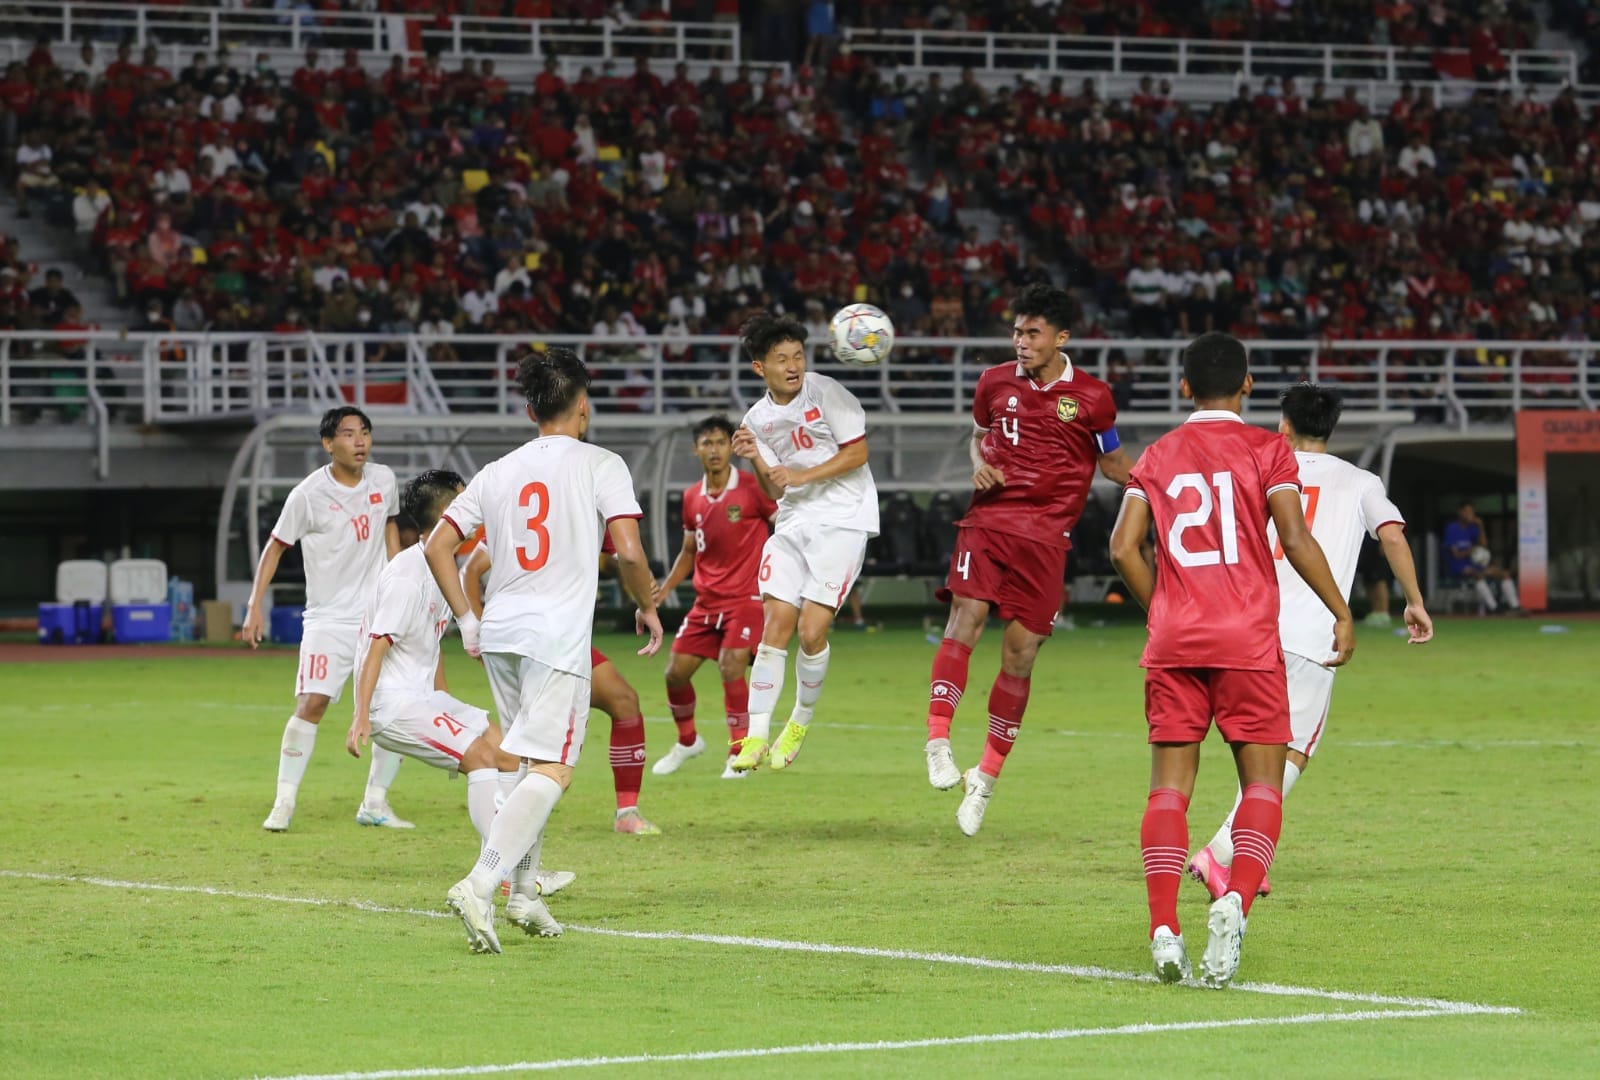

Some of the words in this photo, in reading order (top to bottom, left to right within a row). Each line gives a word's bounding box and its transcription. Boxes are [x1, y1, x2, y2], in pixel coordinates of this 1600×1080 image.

[791, 426, 813, 450] 16
[1001, 417, 1018, 446] 4
[351, 514, 369, 541] 18
[515, 481, 550, 571] 3
[1166, 472, 1239, 567] 21
[695, 528, 706, 552] 8
[956, 551, 970, 580] 4
[309, 654, 328, 680] 18
